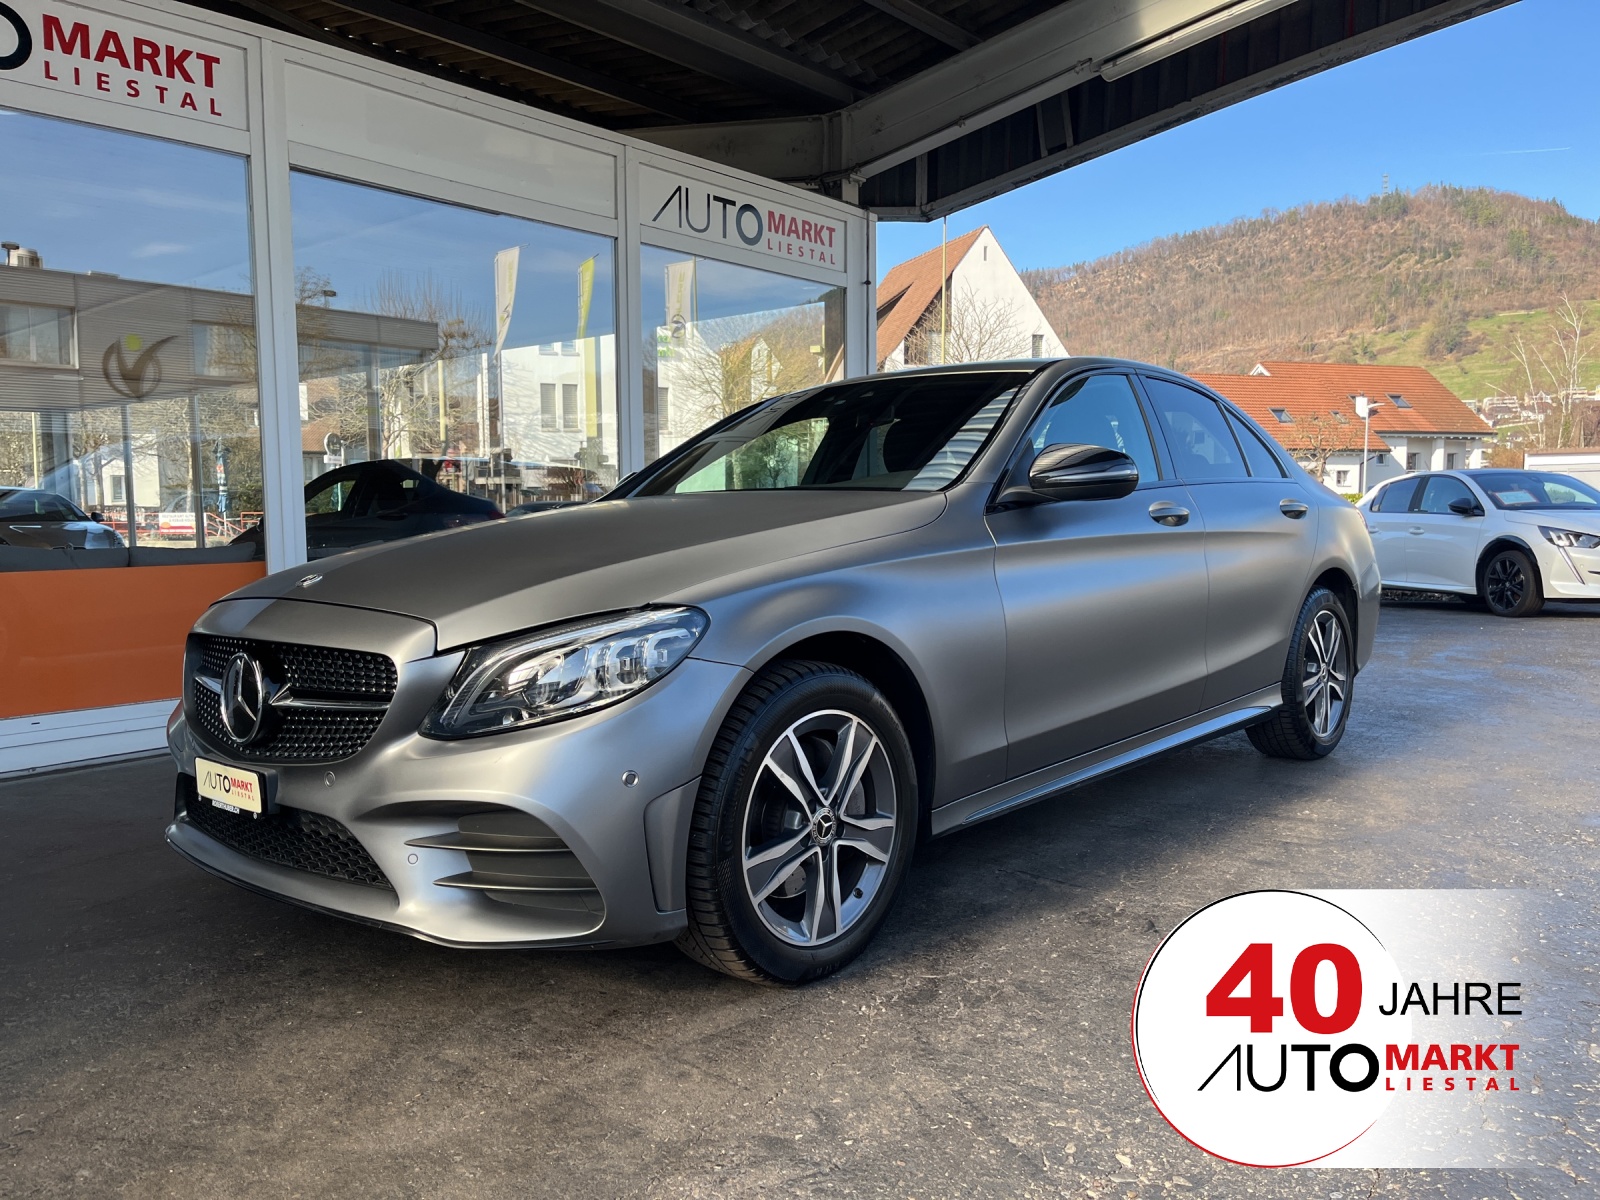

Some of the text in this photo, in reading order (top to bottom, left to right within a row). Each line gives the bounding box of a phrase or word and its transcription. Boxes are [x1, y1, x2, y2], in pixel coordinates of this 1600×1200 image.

[42, 13, 221, 89] MARKT
[43, 60, 222, 117] LIESTAL
[767, 210, 836, 248] MARKT
[767, 238, 836, 265] LIESTAL
[231, 778, 253, 792] MARKT
